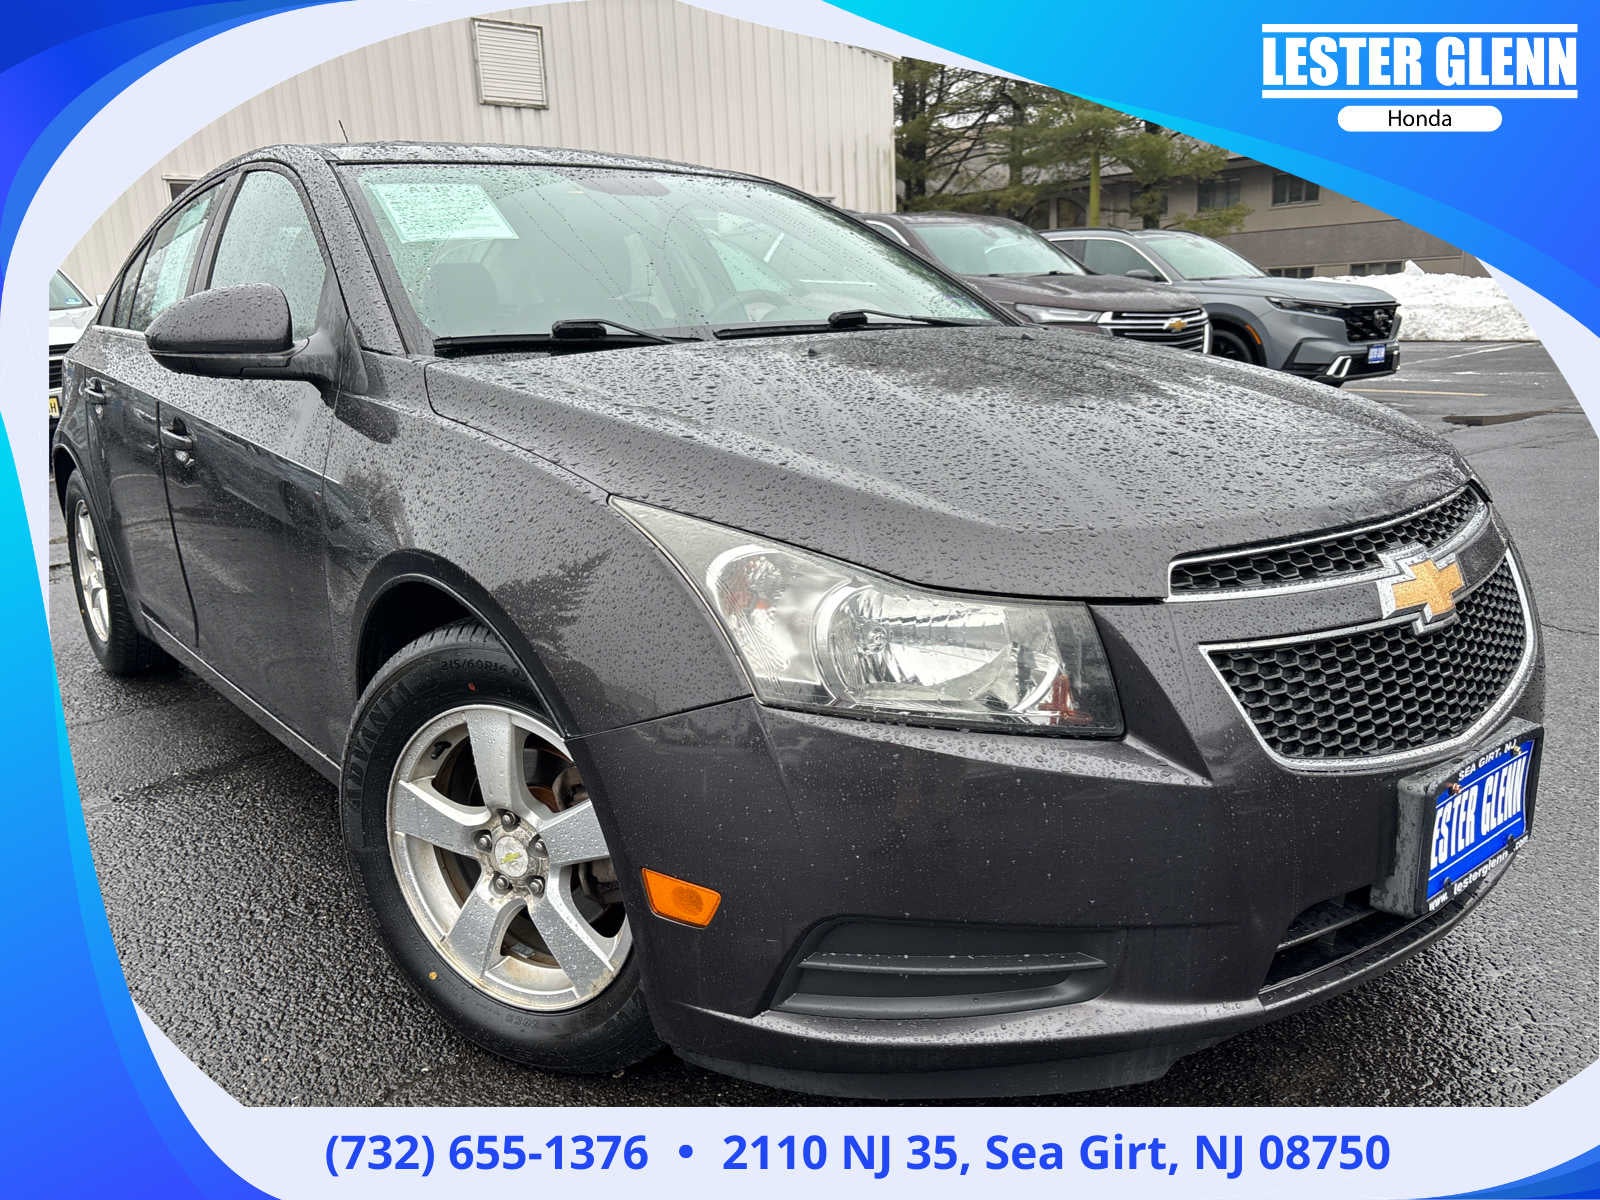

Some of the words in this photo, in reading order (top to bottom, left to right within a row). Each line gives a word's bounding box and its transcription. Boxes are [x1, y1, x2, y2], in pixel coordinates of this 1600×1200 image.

[1458, 763, 1477, 781] SEA
[1504, 738, 1517, 754] NJ
[1430, 784, 1479, 871] ESTER
[1481, 755, 1528, 836] GLENN
